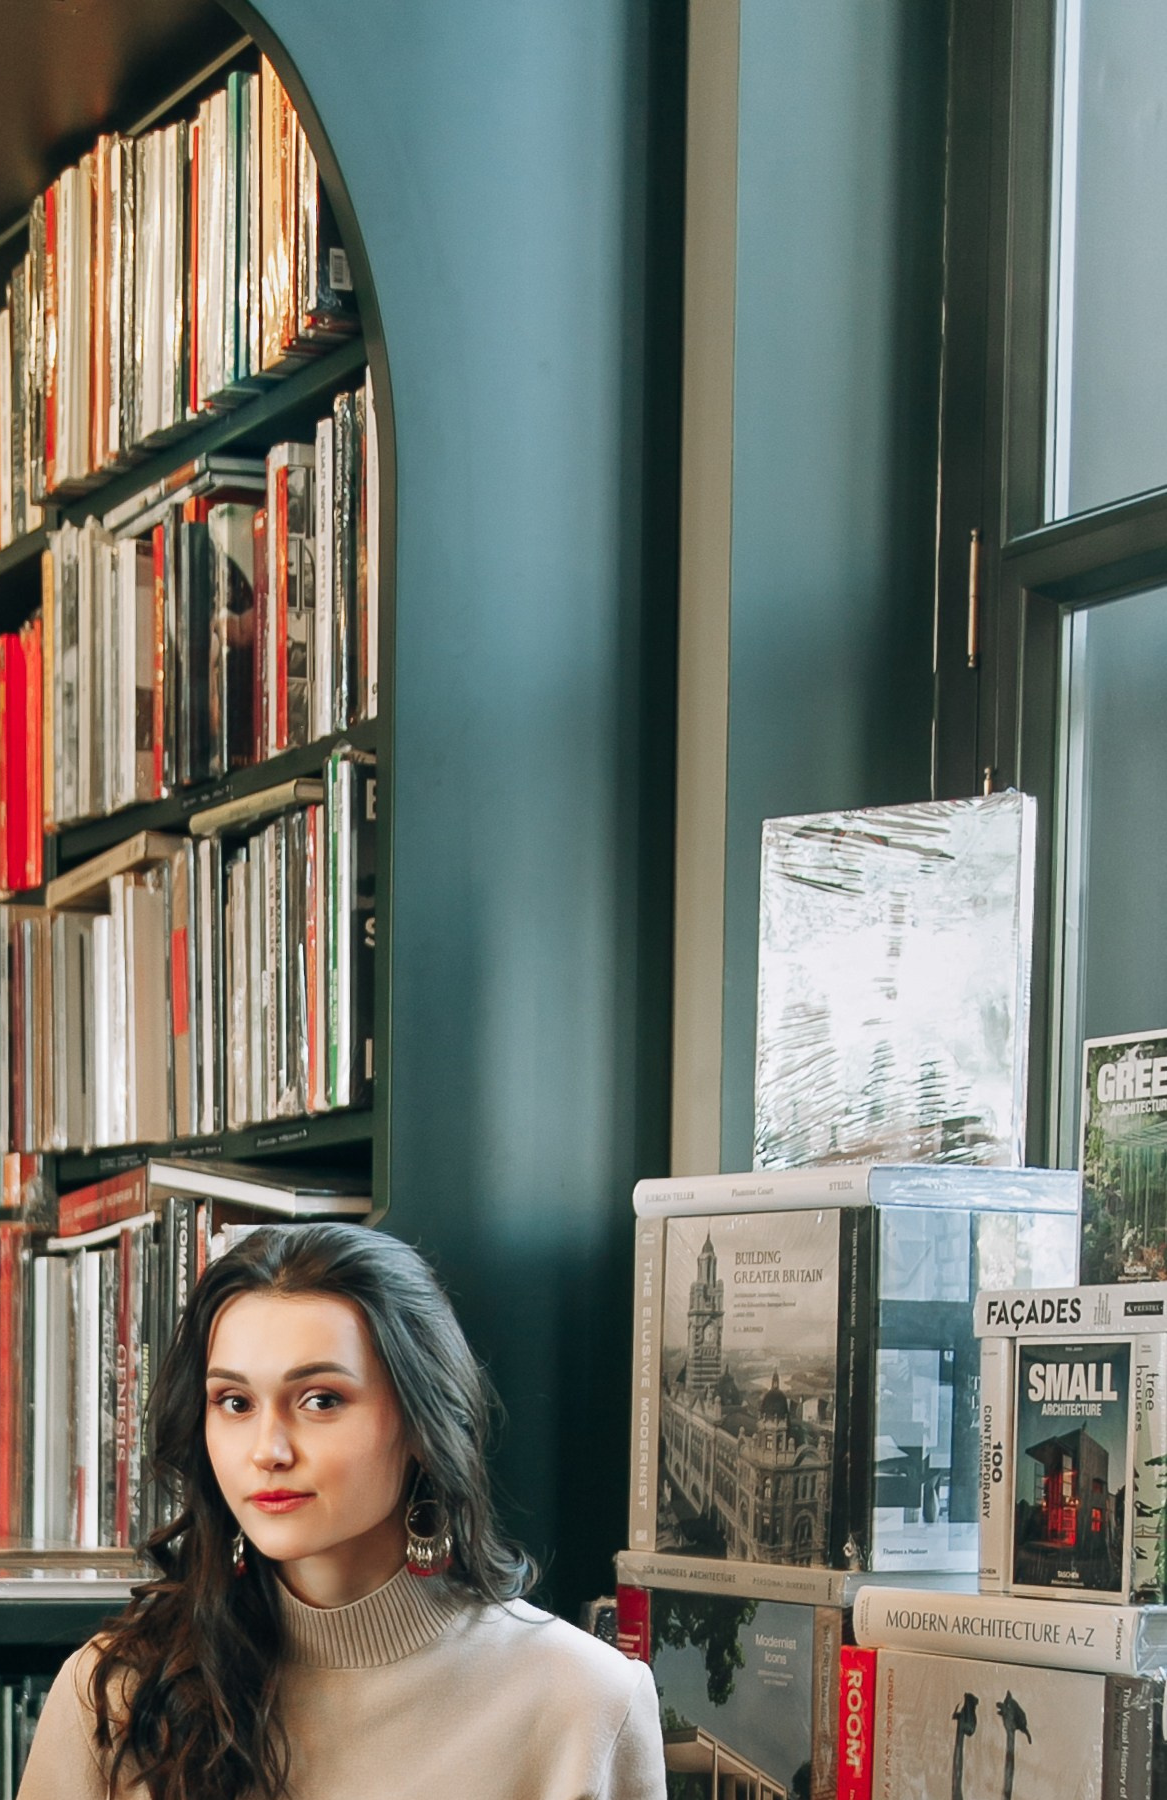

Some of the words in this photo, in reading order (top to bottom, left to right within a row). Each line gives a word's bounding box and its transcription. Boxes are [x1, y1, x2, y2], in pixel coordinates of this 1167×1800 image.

[178, 1217, 188, 1307] TOMASZ
[733, 1270, 780, 1284] GREATER
[782, 1269, 824, 1283] BRITAIN
[735, 1250, 781, 1265] BUILDING
[642, 1258, 653, 1297] THE
[987, 1297, 1082, 1331] FAÇADES
[640, 1307, 651, 1388] ELUSIVE
[1028, 1362, 1118, 1402] SMALL
[1136, 1365, 1149, 1432] houses
[1145, 1373, 1159, 1411] tree
[116, 1344, 127, 1461] GENESIS
[1041, 1403, 1102, 1417] ARCHITECTURE
[638, 1397, 649, 1510] MODERNIST
[982, 1405, 992, 1519] CONTEMPORARY
[992, 1441, 1003, 1483] 100
[689, 1569, 736, 1583] ARCHITECTURE
[755, 1633, 797, 1650] Modernist
[886, 1609, 948, 1632] MODERN
[951, 1616, 1060, 1644] ARCHITECTURE
[1115, 1618, 1124, 1661] TASCHEN
[764, 1650, 787, 1665] Icons
[1123, 1688, 1132, 1708] The
[846, 1669, 863, 1766] ROOM
[1121, 1711, 1131, 1743] Visual
[1119, 1746, 1129, 1784] History
[1120, 1787, 1128, 1798] of
